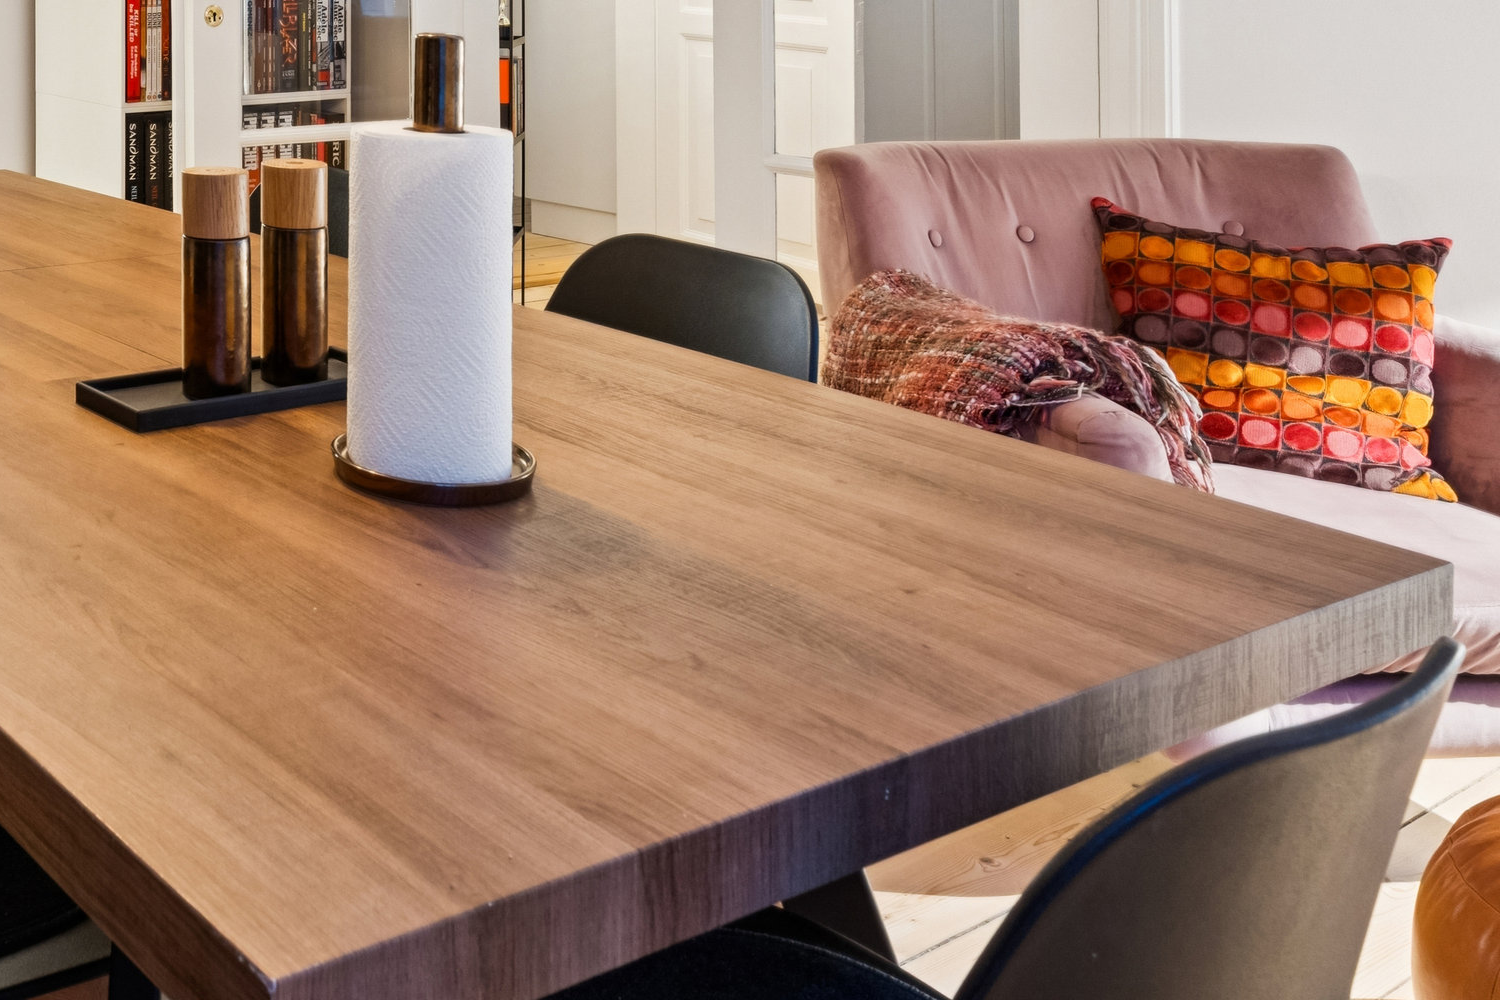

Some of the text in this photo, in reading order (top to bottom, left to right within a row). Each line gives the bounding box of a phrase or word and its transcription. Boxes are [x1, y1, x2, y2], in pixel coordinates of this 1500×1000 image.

[129, 123, 138, 180] SANDMAN
[149, 123, 158, 180] SANDMAN
[332, 141, 340, 167] RIC
